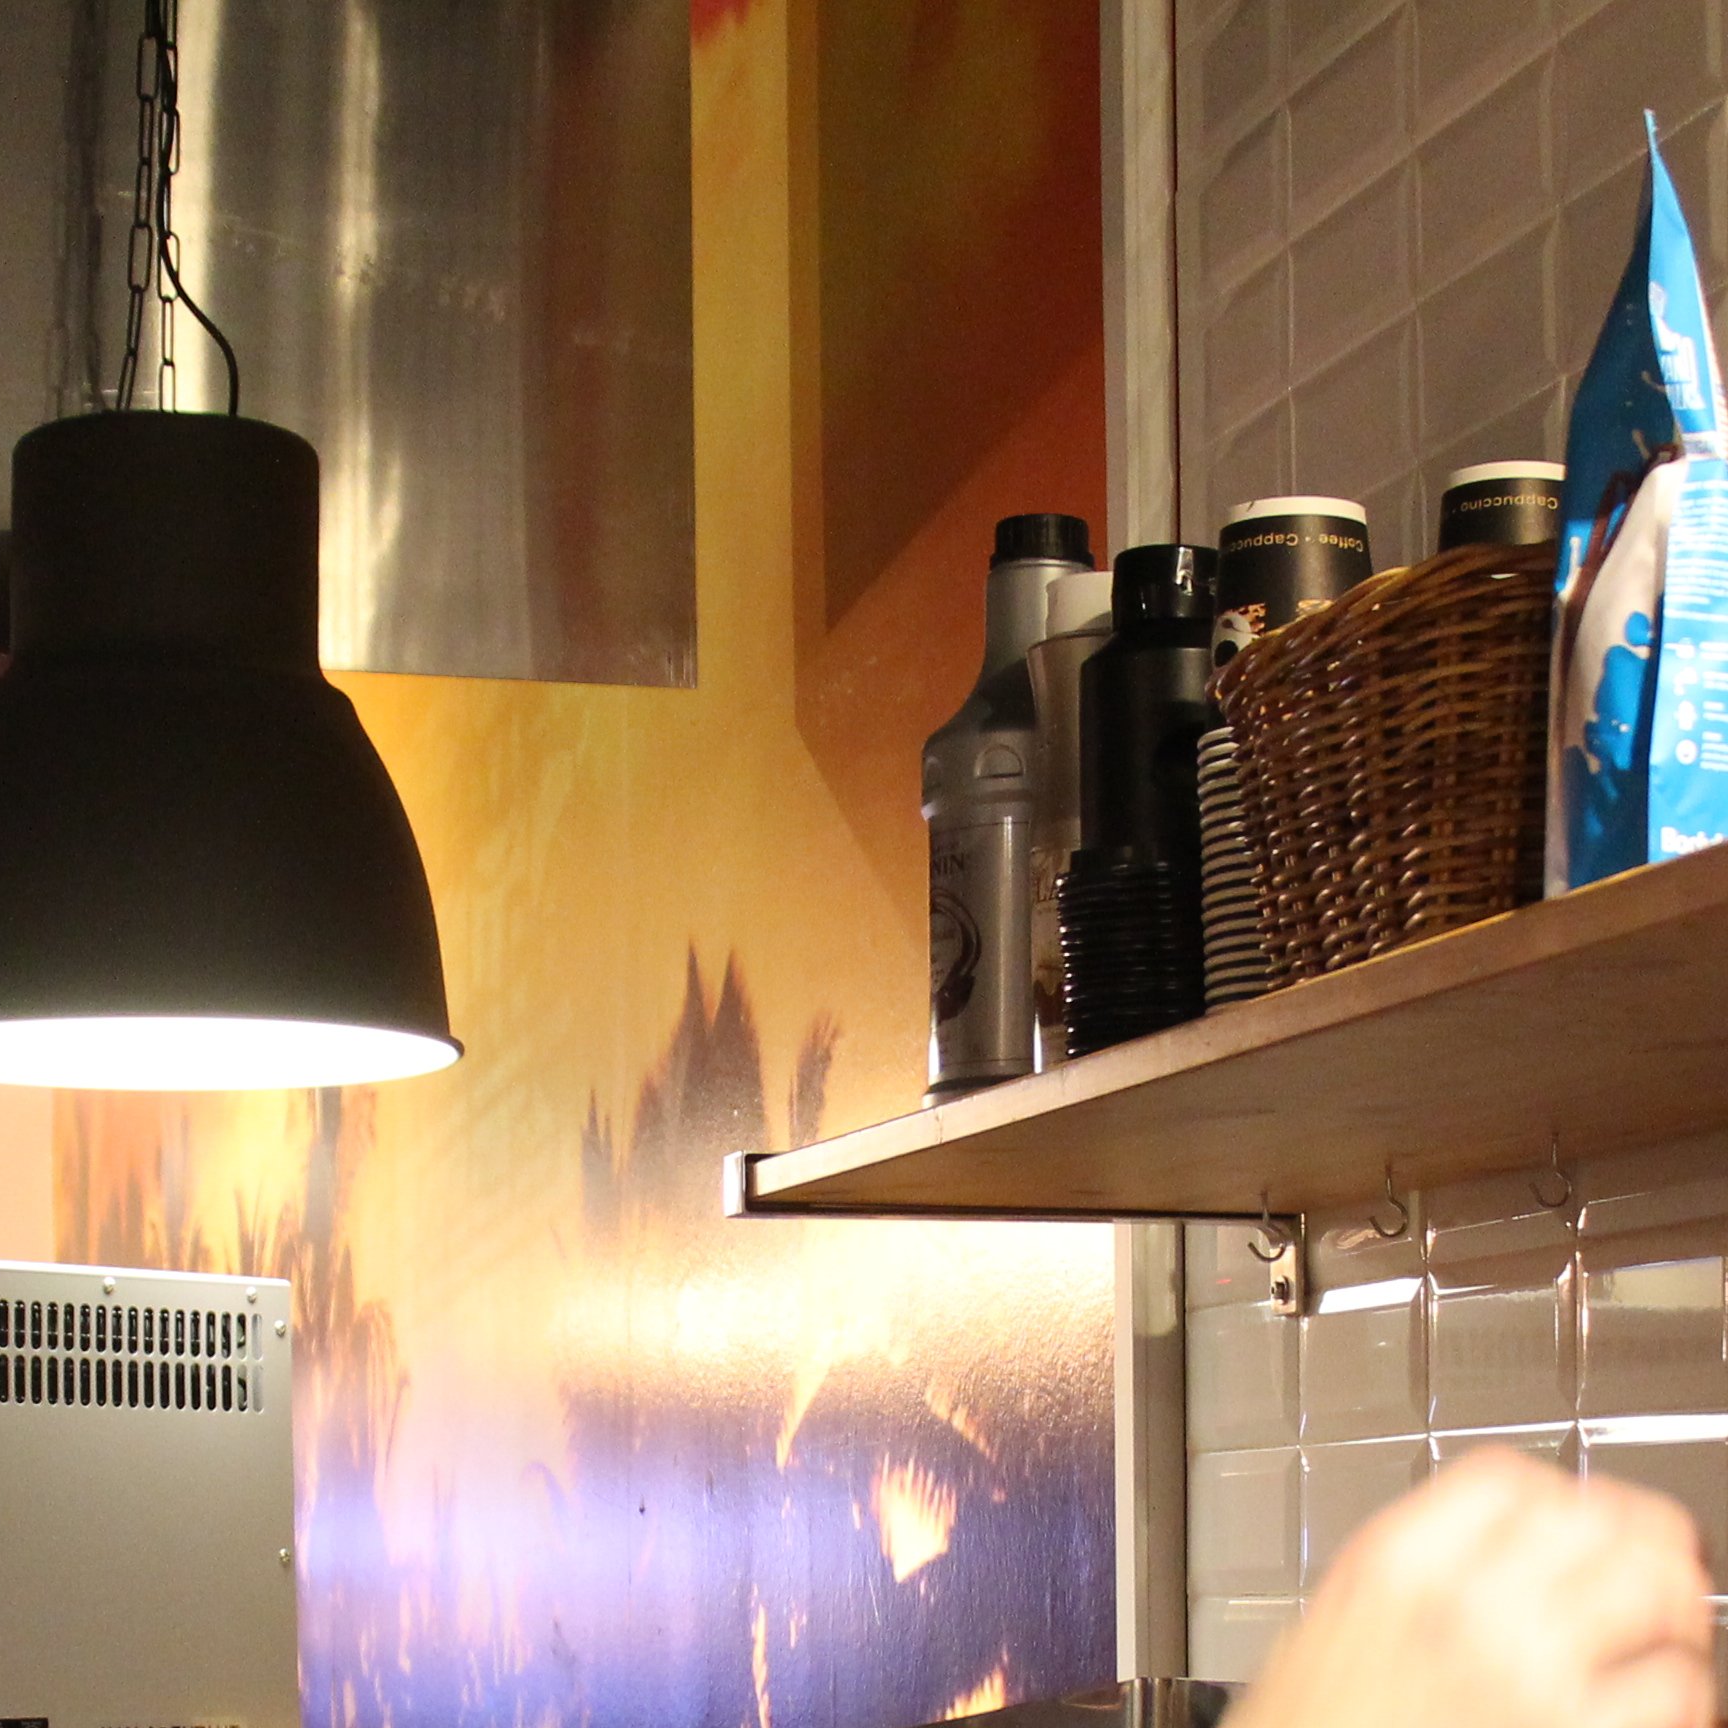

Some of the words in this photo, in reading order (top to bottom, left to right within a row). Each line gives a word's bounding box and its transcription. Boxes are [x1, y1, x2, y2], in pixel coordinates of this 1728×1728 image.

[1460, 496, 1558, 512] Cappuccino
[1230, 532, 1299, 551] Cappucc
[1318, 533, 1364, 553] Coffee
